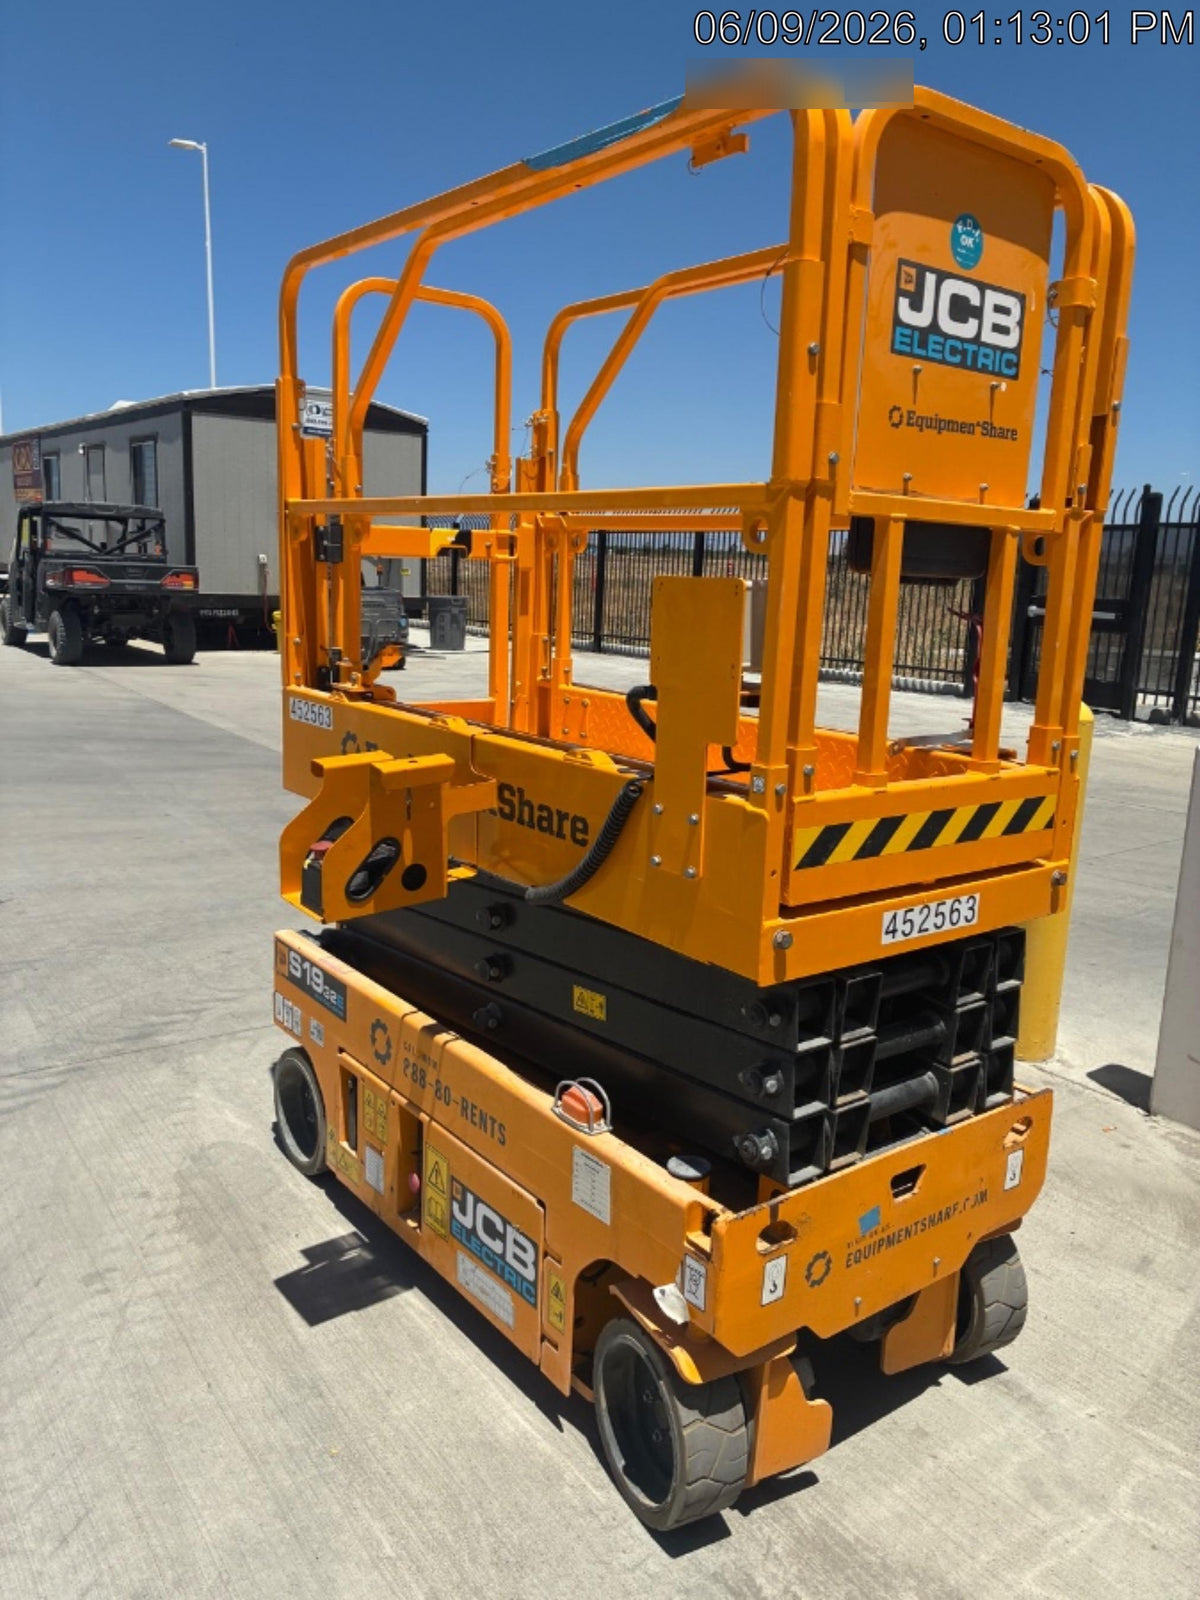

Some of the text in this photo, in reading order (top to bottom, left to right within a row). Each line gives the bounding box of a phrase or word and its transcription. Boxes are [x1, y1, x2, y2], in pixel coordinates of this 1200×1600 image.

[897, 271, 1021, 349] JCB
[893, 325, 1018, 376] ELECTRIC
[291, 698, 332, 728] 452563
[489, 781, 590, 848] Share
[884, 895, 977, 939] 452563
[451, 1218, 536, 1304] ELECTRIC
[452, 1191, 536, 1282] JCB
